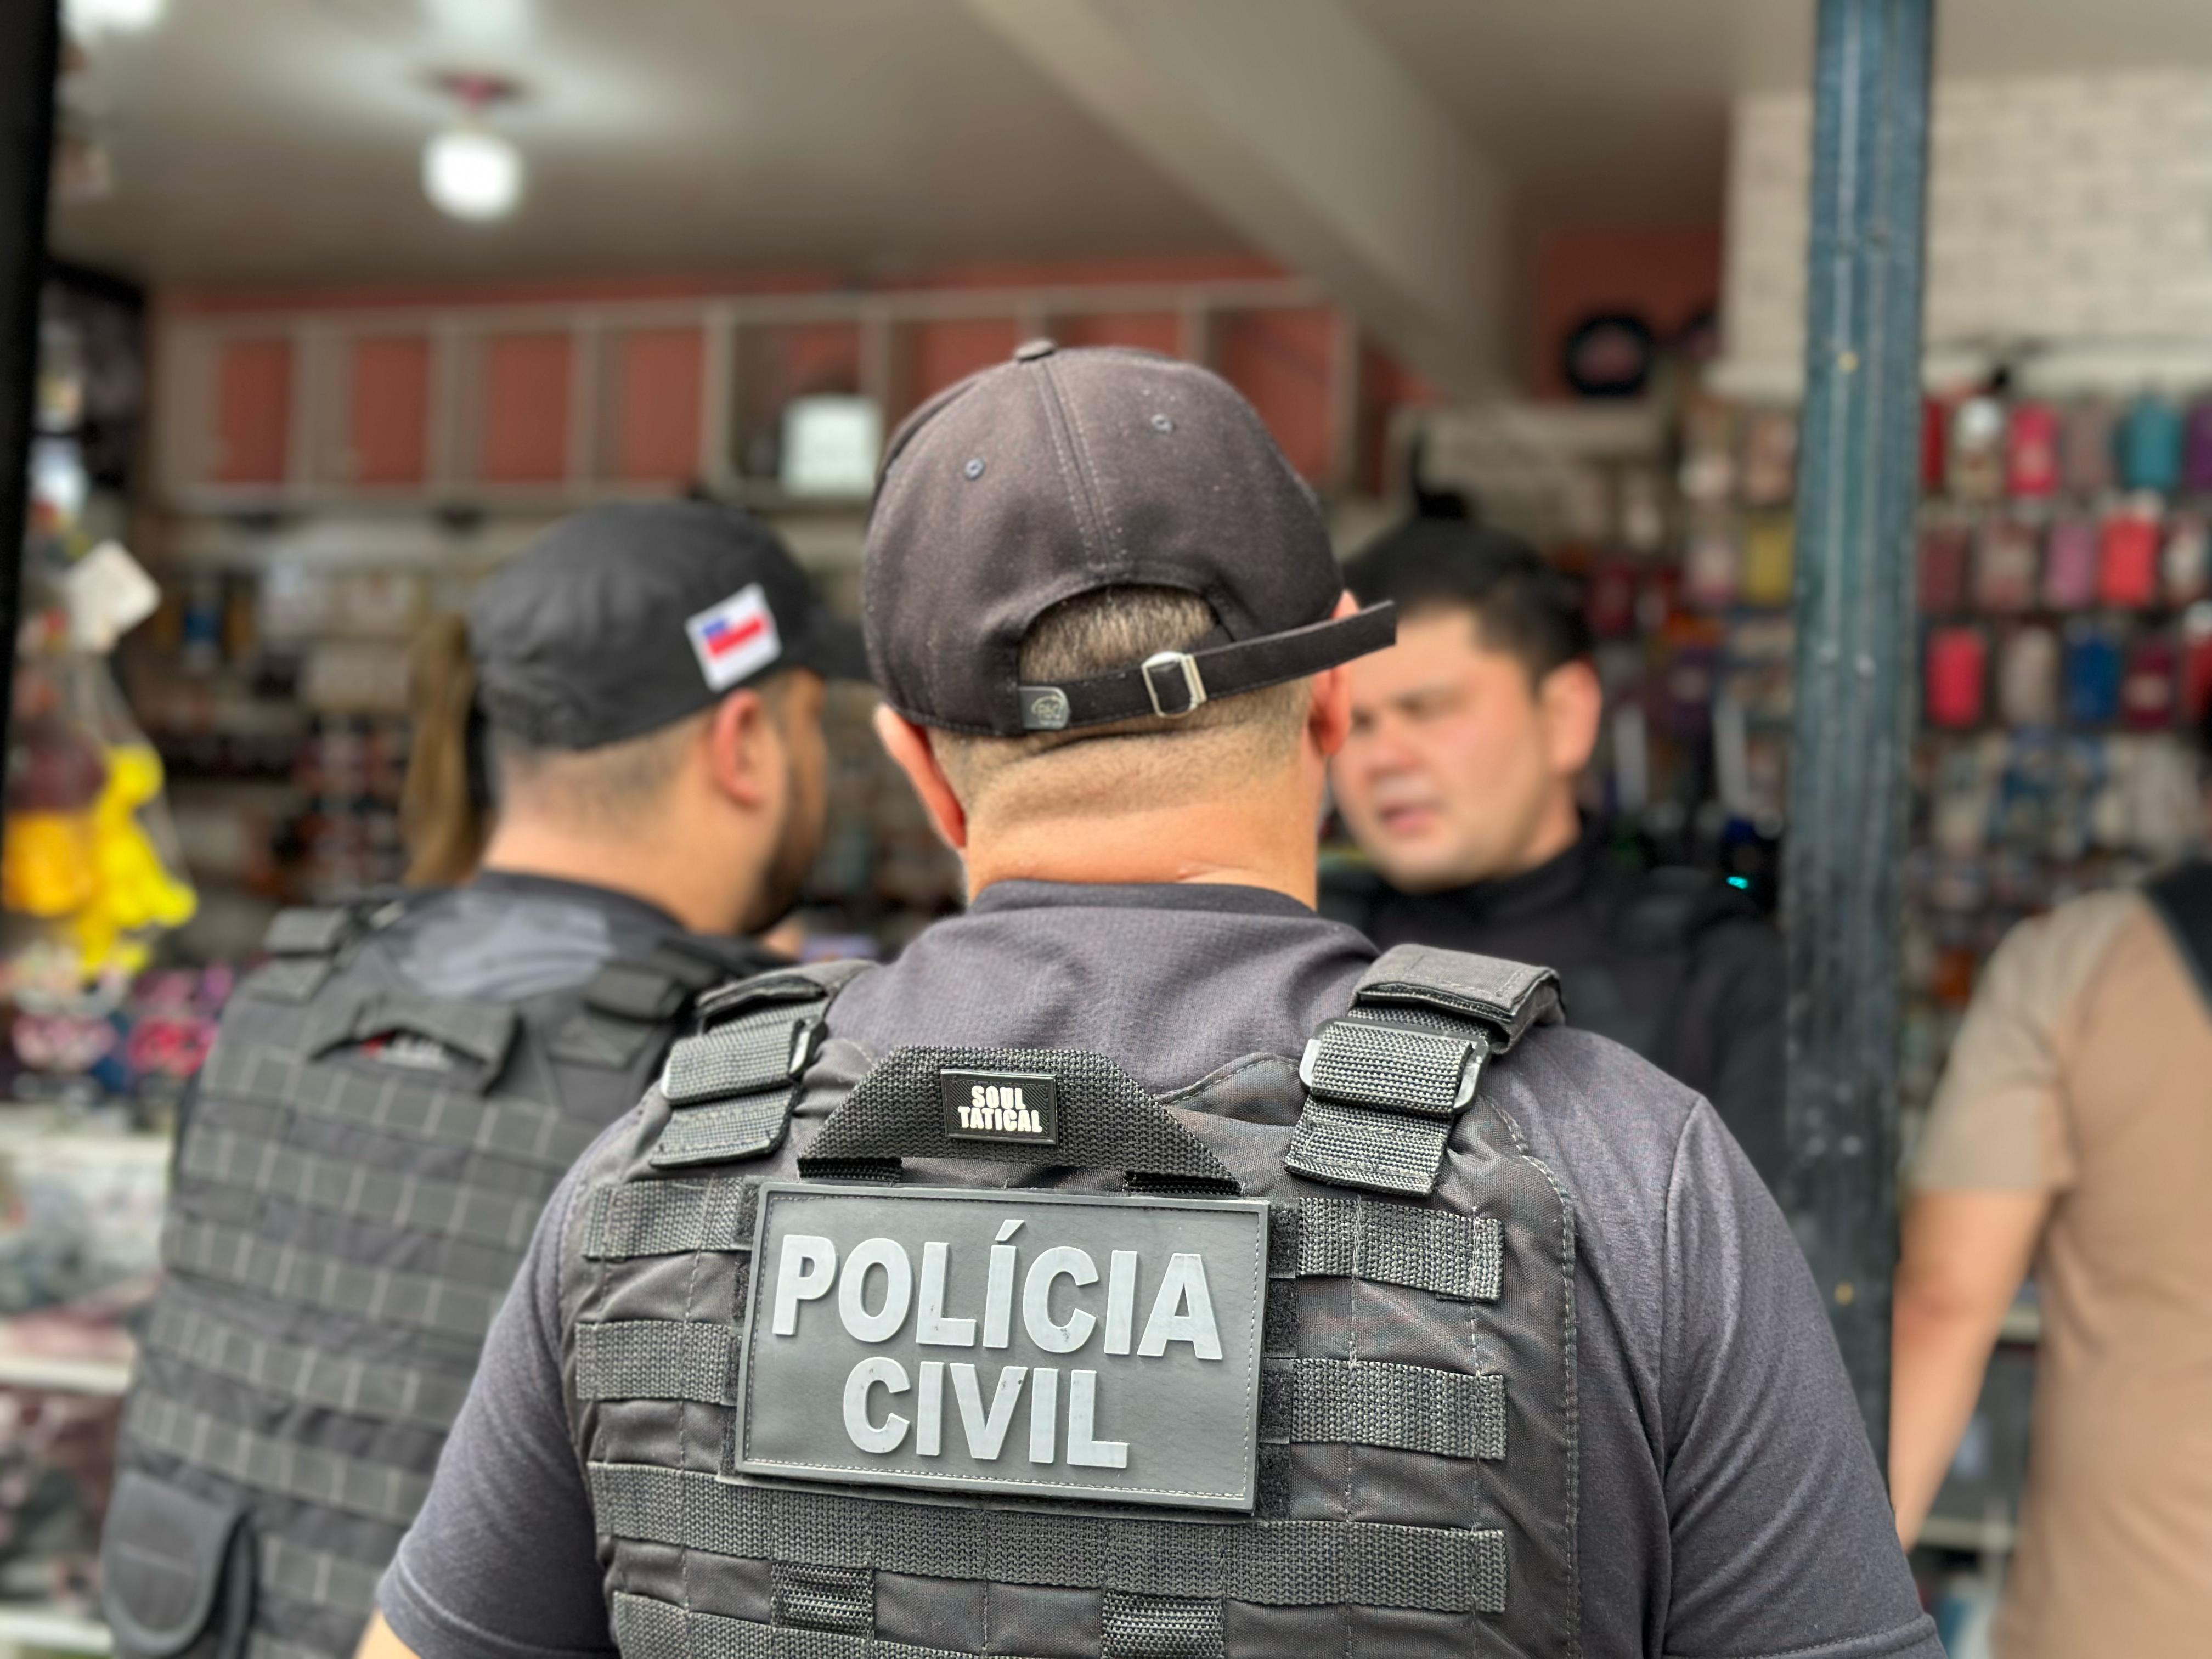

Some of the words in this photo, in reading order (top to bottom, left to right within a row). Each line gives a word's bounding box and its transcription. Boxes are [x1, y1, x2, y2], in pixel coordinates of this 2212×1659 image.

[958, 1106, 1042, 1132] TATICAL
[972, 1086, 1026, 1109] SOUL
[772, 1219, 1223, 1360] POLÍCIA
[843, 1357, 1129, 1469] CIVIL
